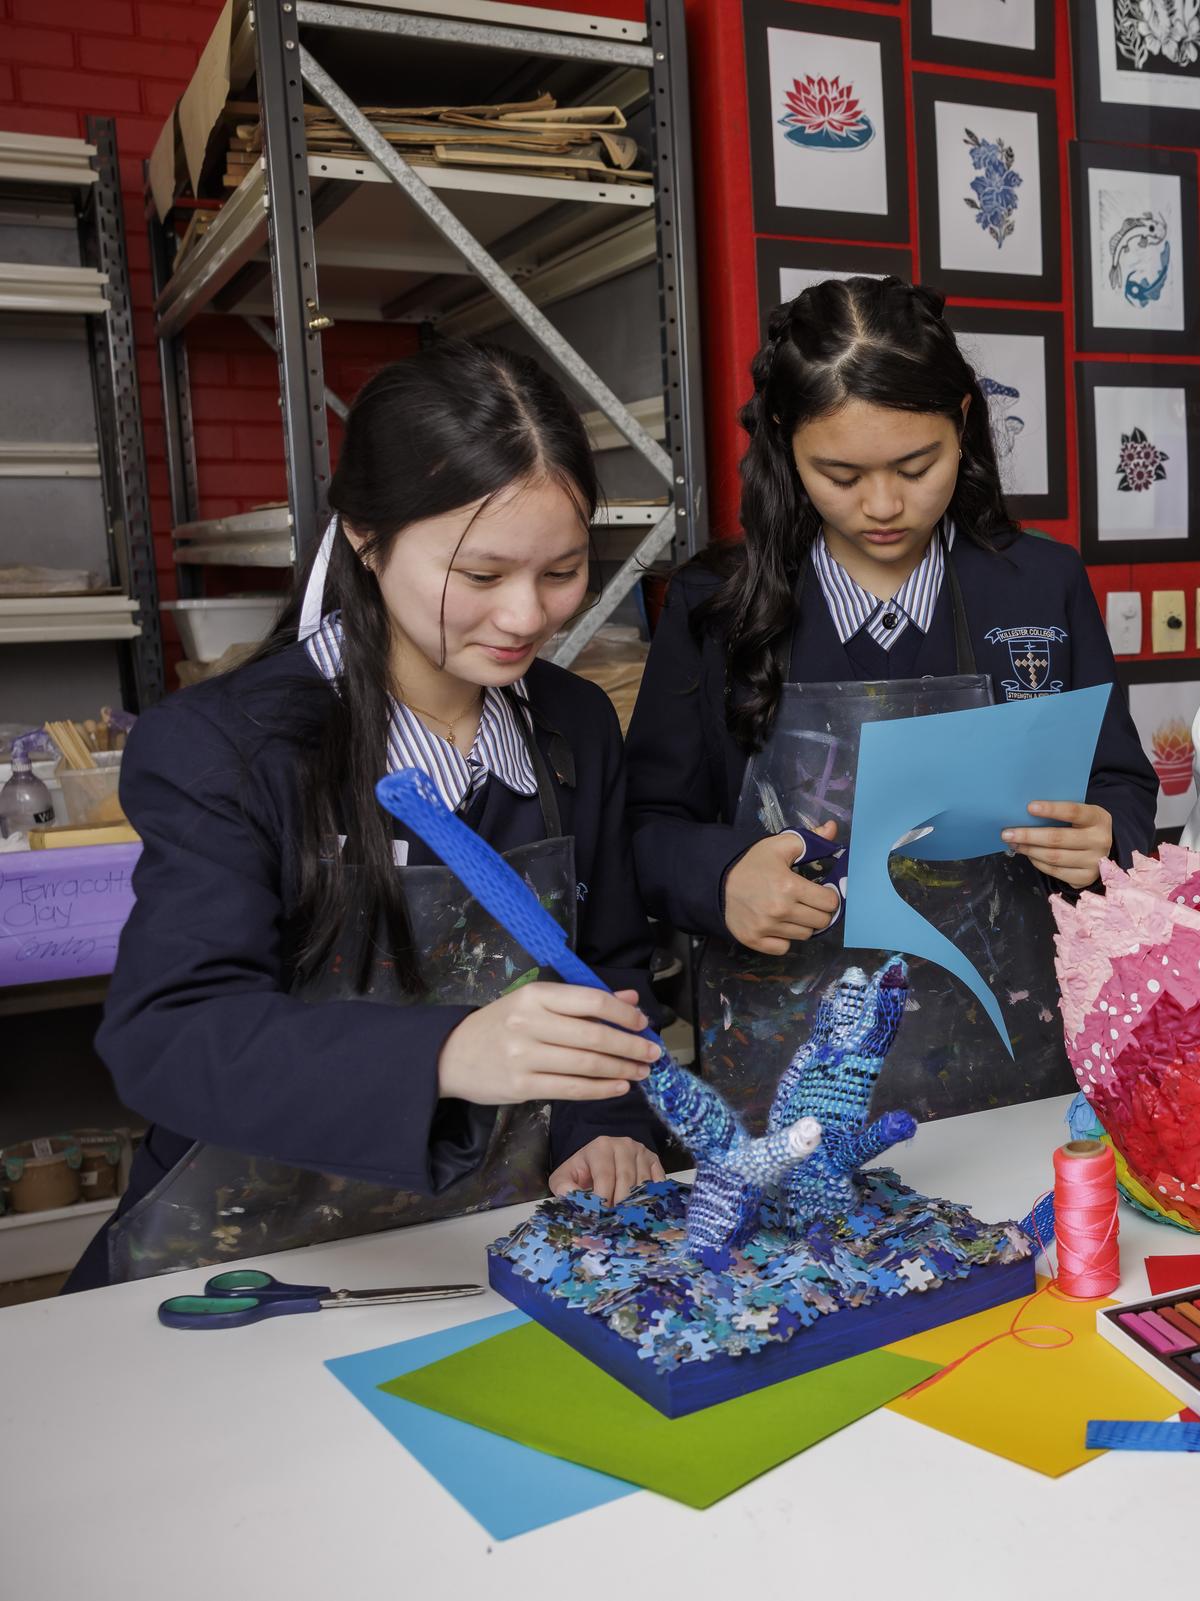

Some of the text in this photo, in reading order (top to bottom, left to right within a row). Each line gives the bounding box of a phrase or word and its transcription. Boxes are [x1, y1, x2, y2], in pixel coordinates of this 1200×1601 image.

[1000, 629, 1055, 640] KILLESTER COLLEGE
[3, 902, 73, 929] Clay
